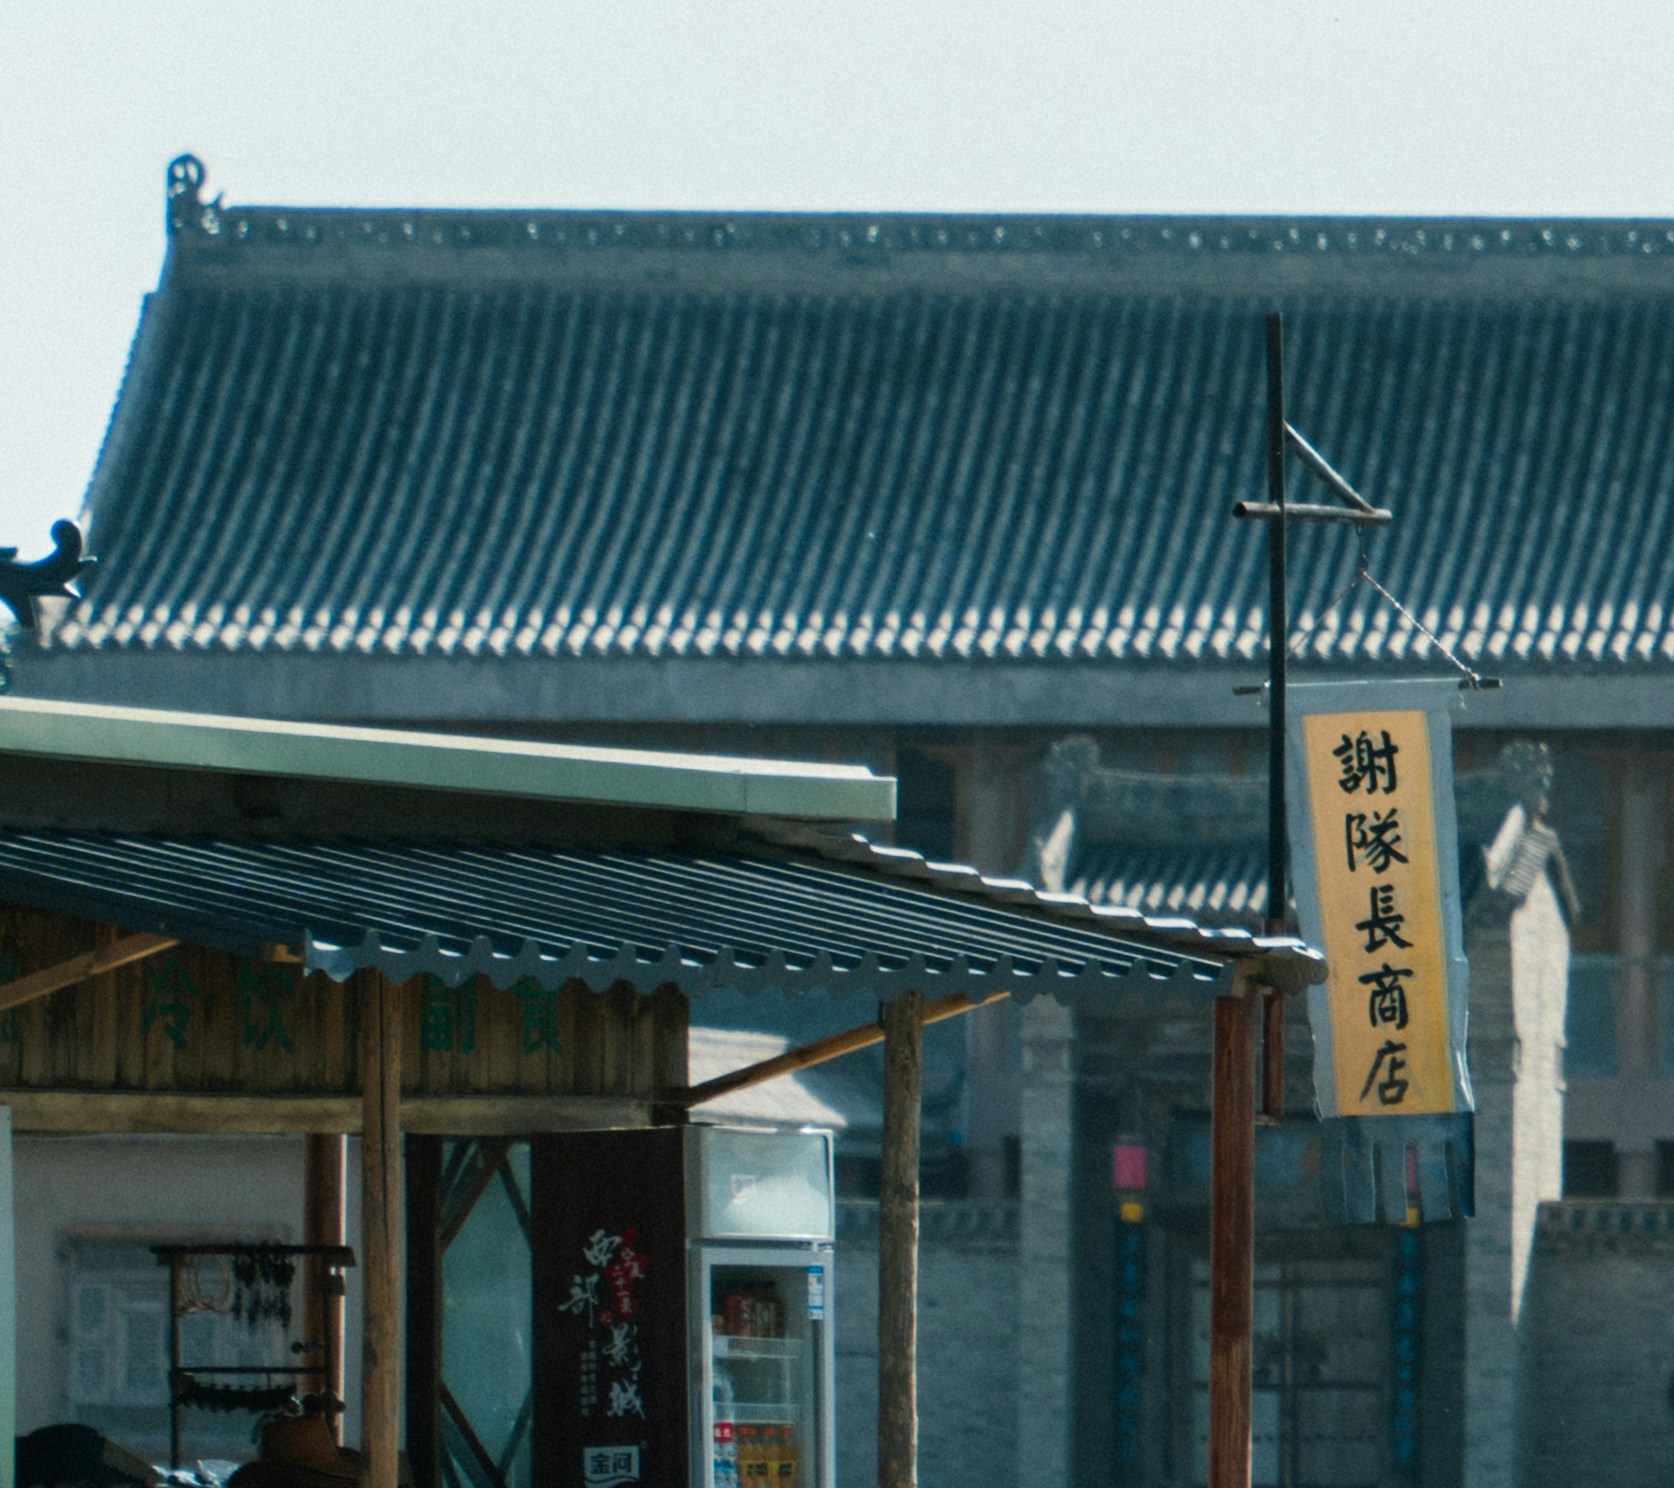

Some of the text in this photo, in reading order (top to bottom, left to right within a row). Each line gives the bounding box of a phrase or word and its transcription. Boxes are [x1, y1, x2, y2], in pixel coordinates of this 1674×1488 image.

[1332, 730, 1413, 1106] 謝隊長商店
